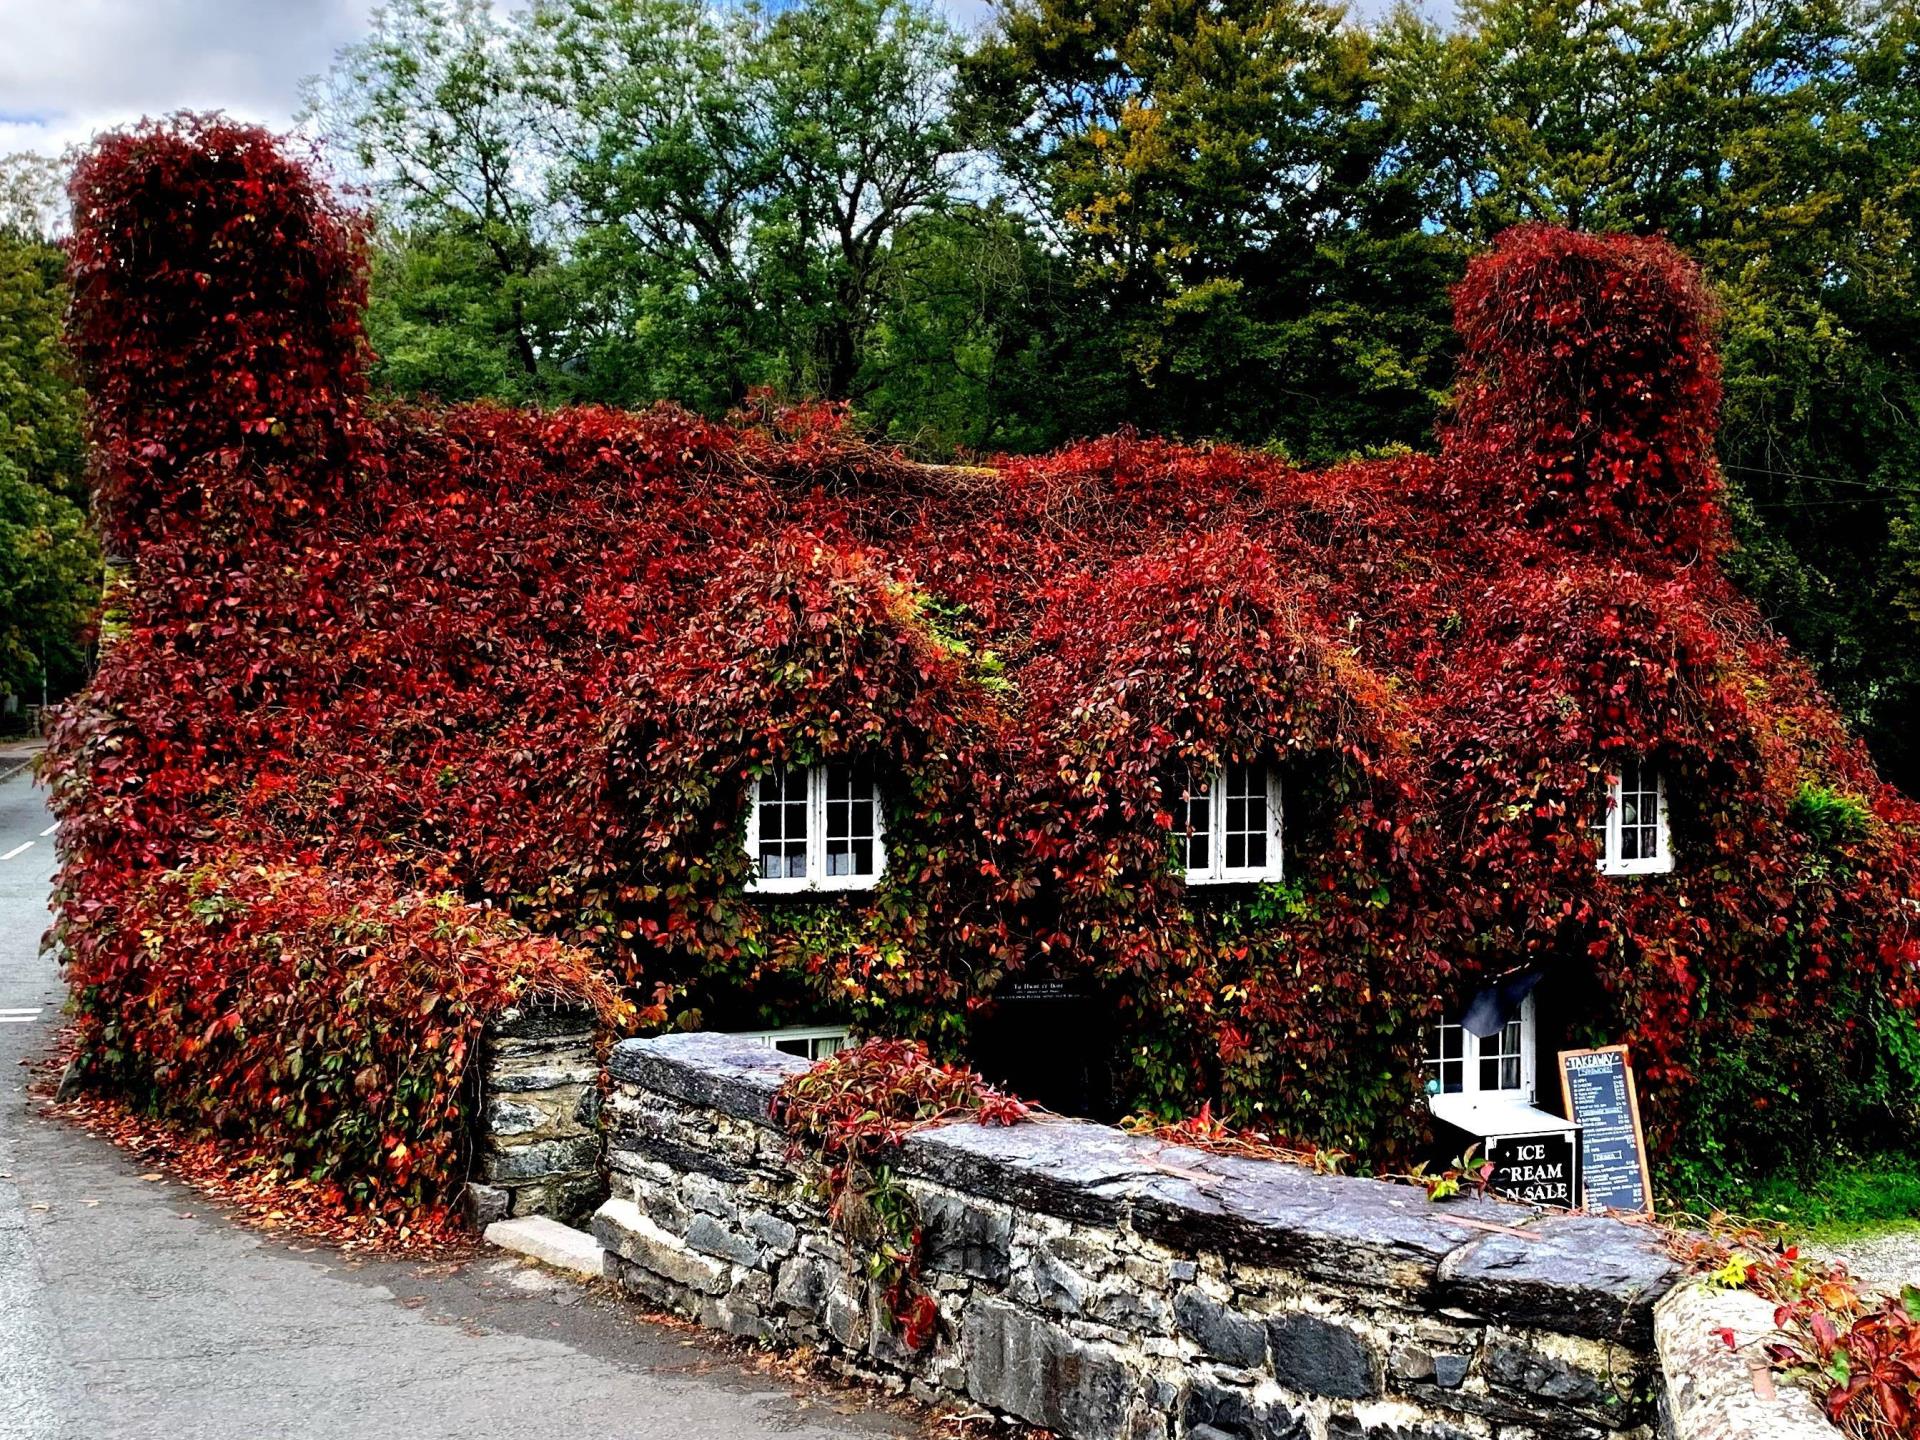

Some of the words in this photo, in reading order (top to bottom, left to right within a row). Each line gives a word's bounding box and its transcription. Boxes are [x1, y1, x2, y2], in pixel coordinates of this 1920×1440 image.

[1568, 1053, 1615, 1069] TAKEAWAY
[1516, 1144, 1546, 1161] ICE
[1525, 1183, 1568, 1201] SALE
